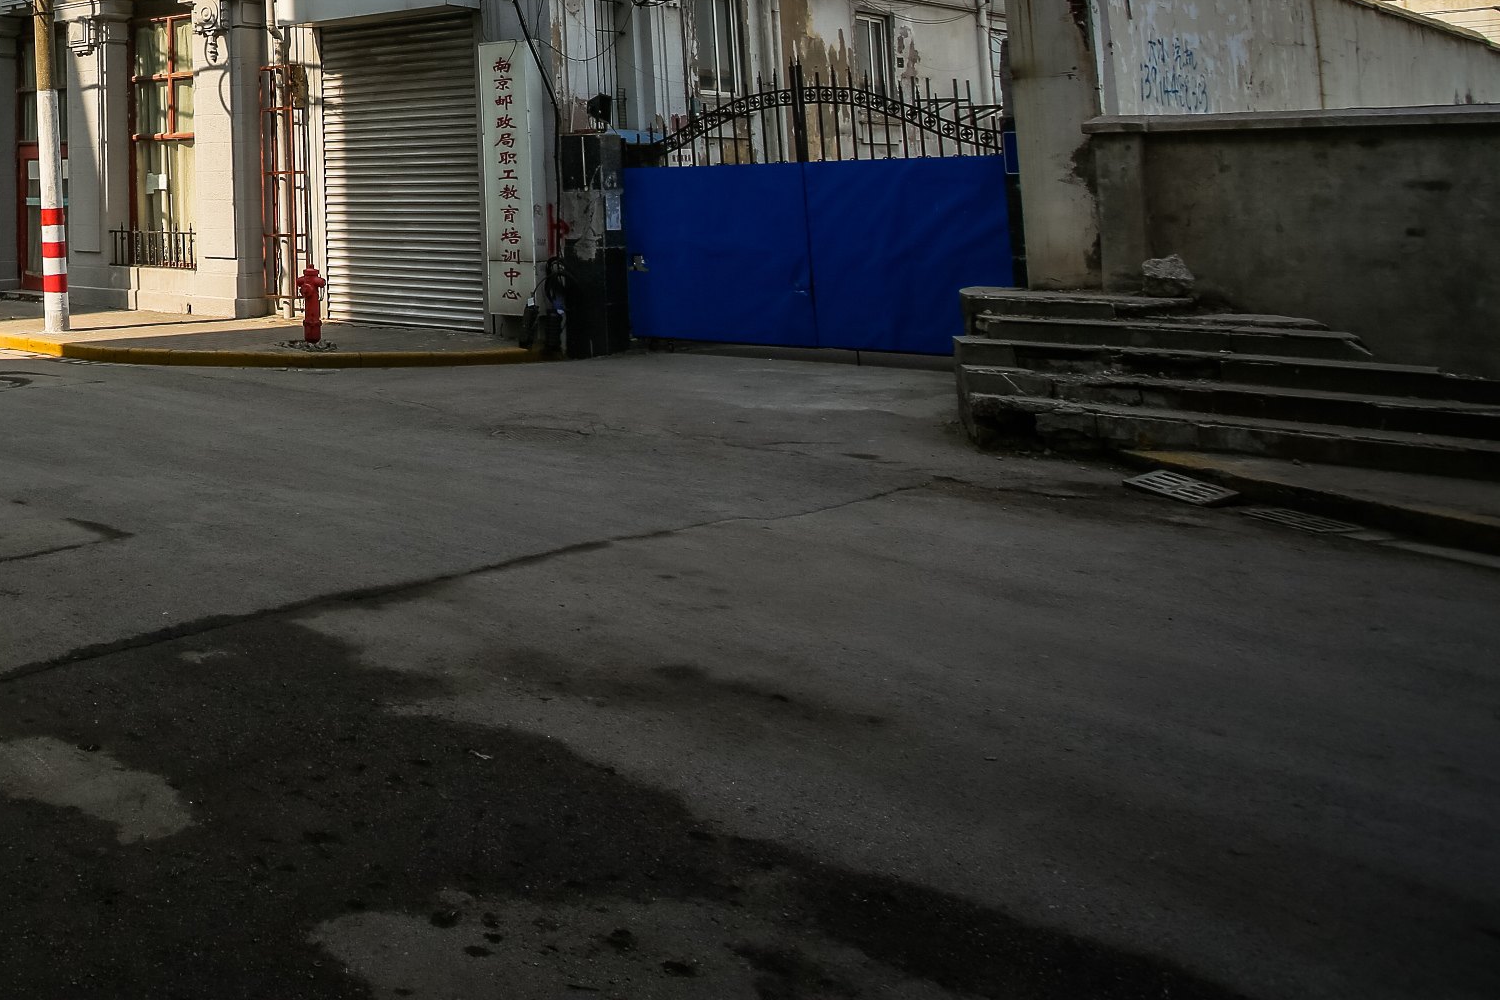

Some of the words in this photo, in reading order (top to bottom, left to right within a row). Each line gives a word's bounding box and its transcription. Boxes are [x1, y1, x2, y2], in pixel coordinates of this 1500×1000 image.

[493, 57, 522, 300] 南京邮政局职工教育培训中心
